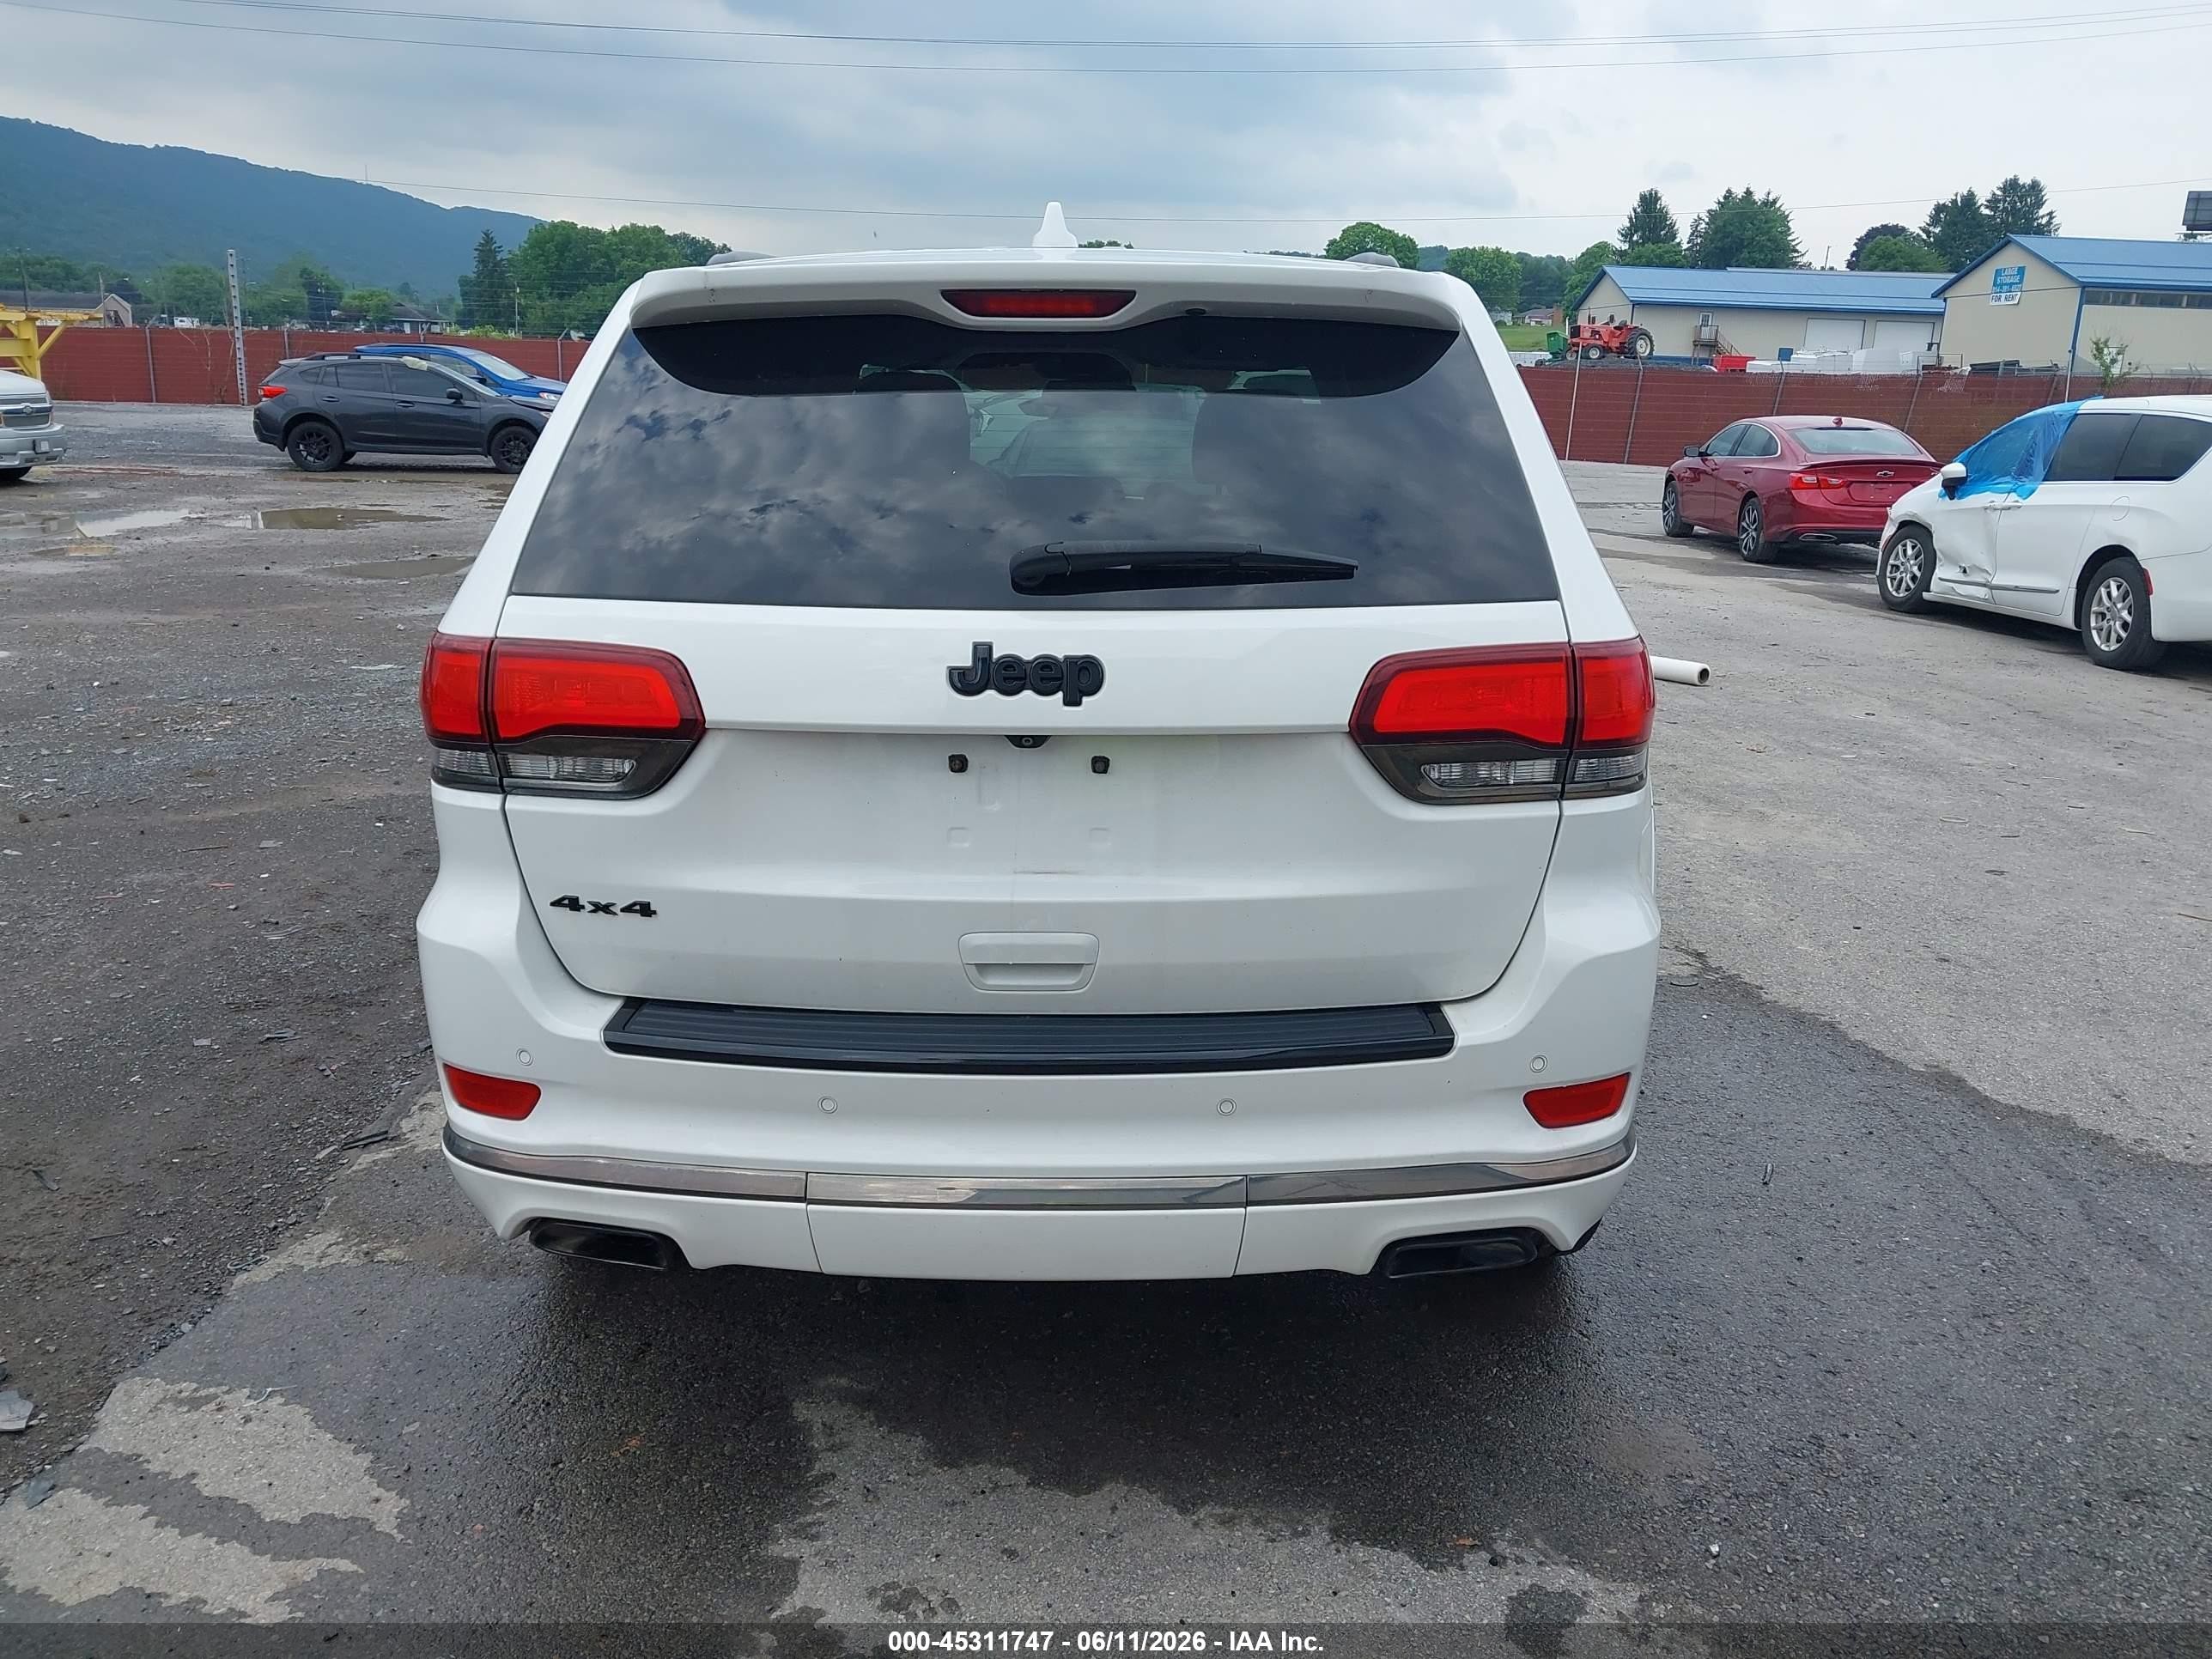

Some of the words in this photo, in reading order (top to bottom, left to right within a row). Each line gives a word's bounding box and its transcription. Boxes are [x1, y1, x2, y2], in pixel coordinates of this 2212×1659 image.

[2001, 267, 2019, 276] LARGE
[1996, 275, 2021, 284] STORAGE
[2004, 294, 2019, 302] RENT
[946, 641, 1104, 707] Jeep
[550, 895, 658, 917] 4x4
